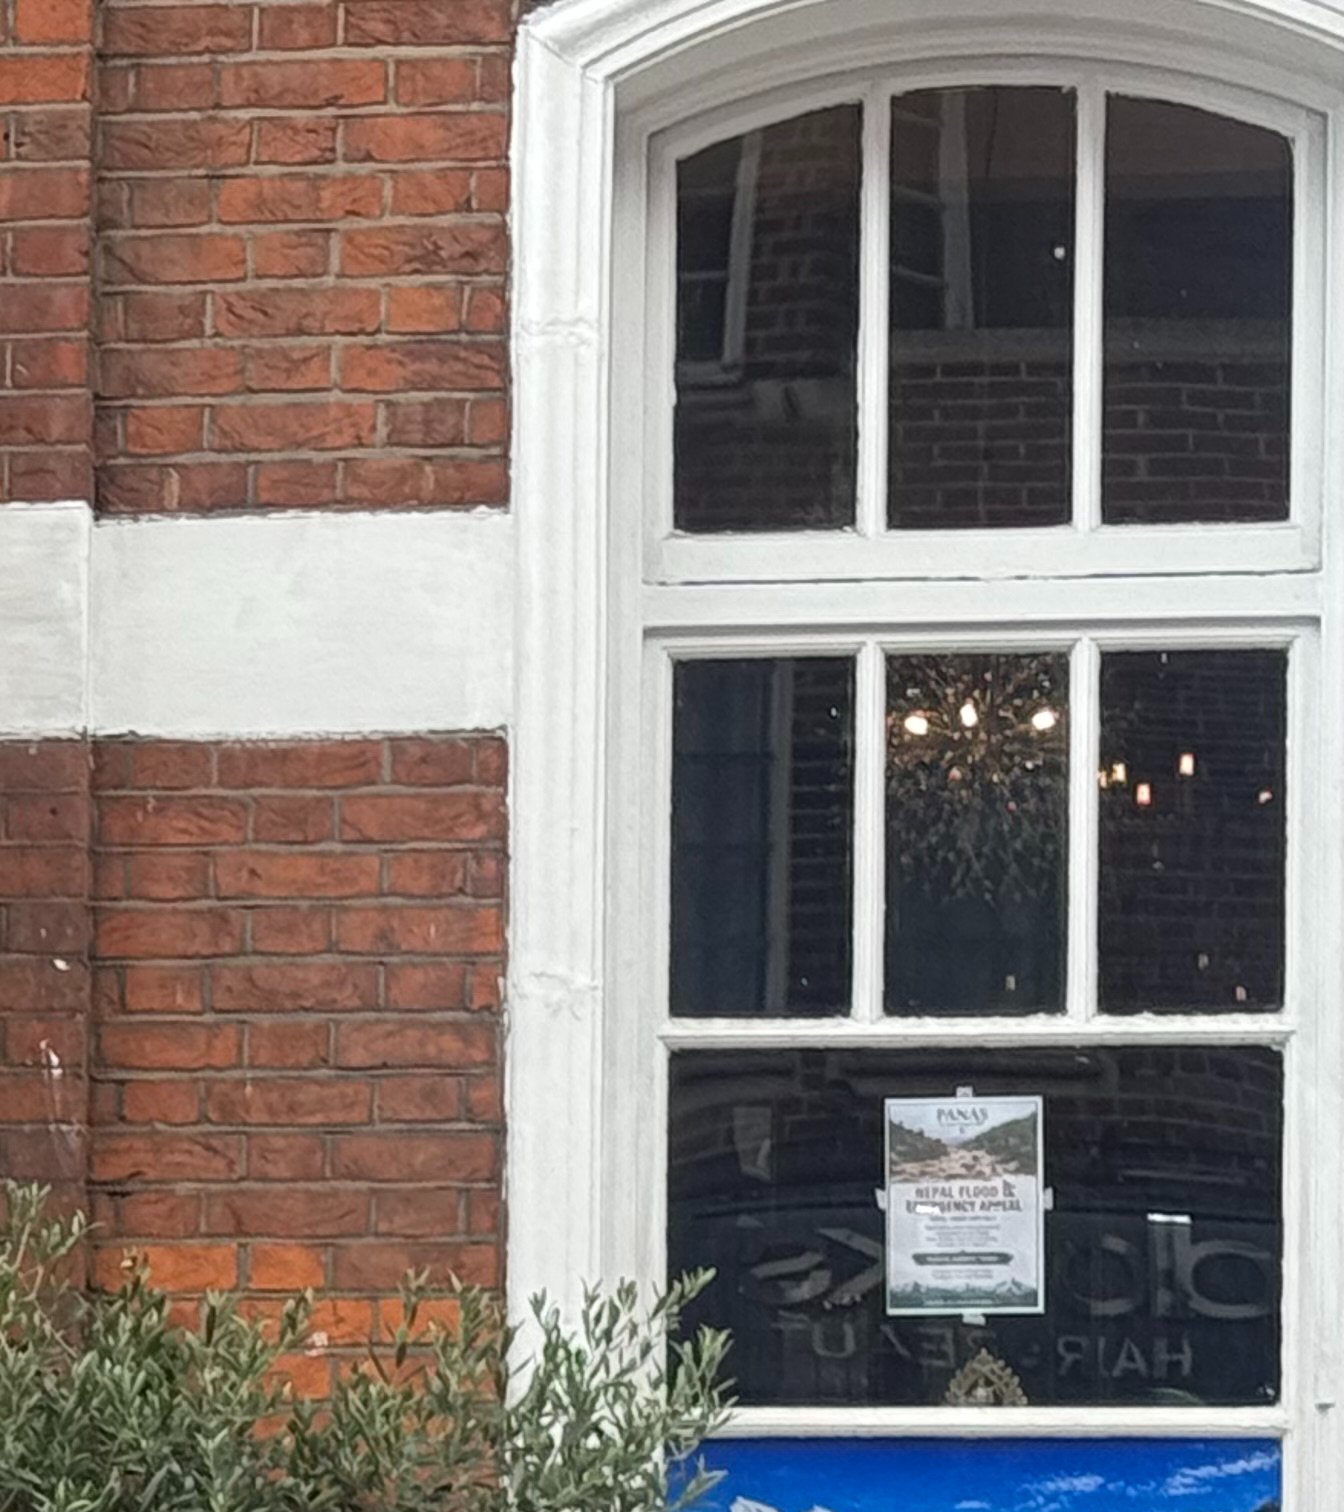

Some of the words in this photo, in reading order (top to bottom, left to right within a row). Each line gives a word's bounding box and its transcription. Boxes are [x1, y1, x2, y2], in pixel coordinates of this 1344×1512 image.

[915, 1186, 954, 1199] NEPAL
[959, 1186, 999, 1199] FLOOD
[906, 1200, 976, 1213] EGENCY
